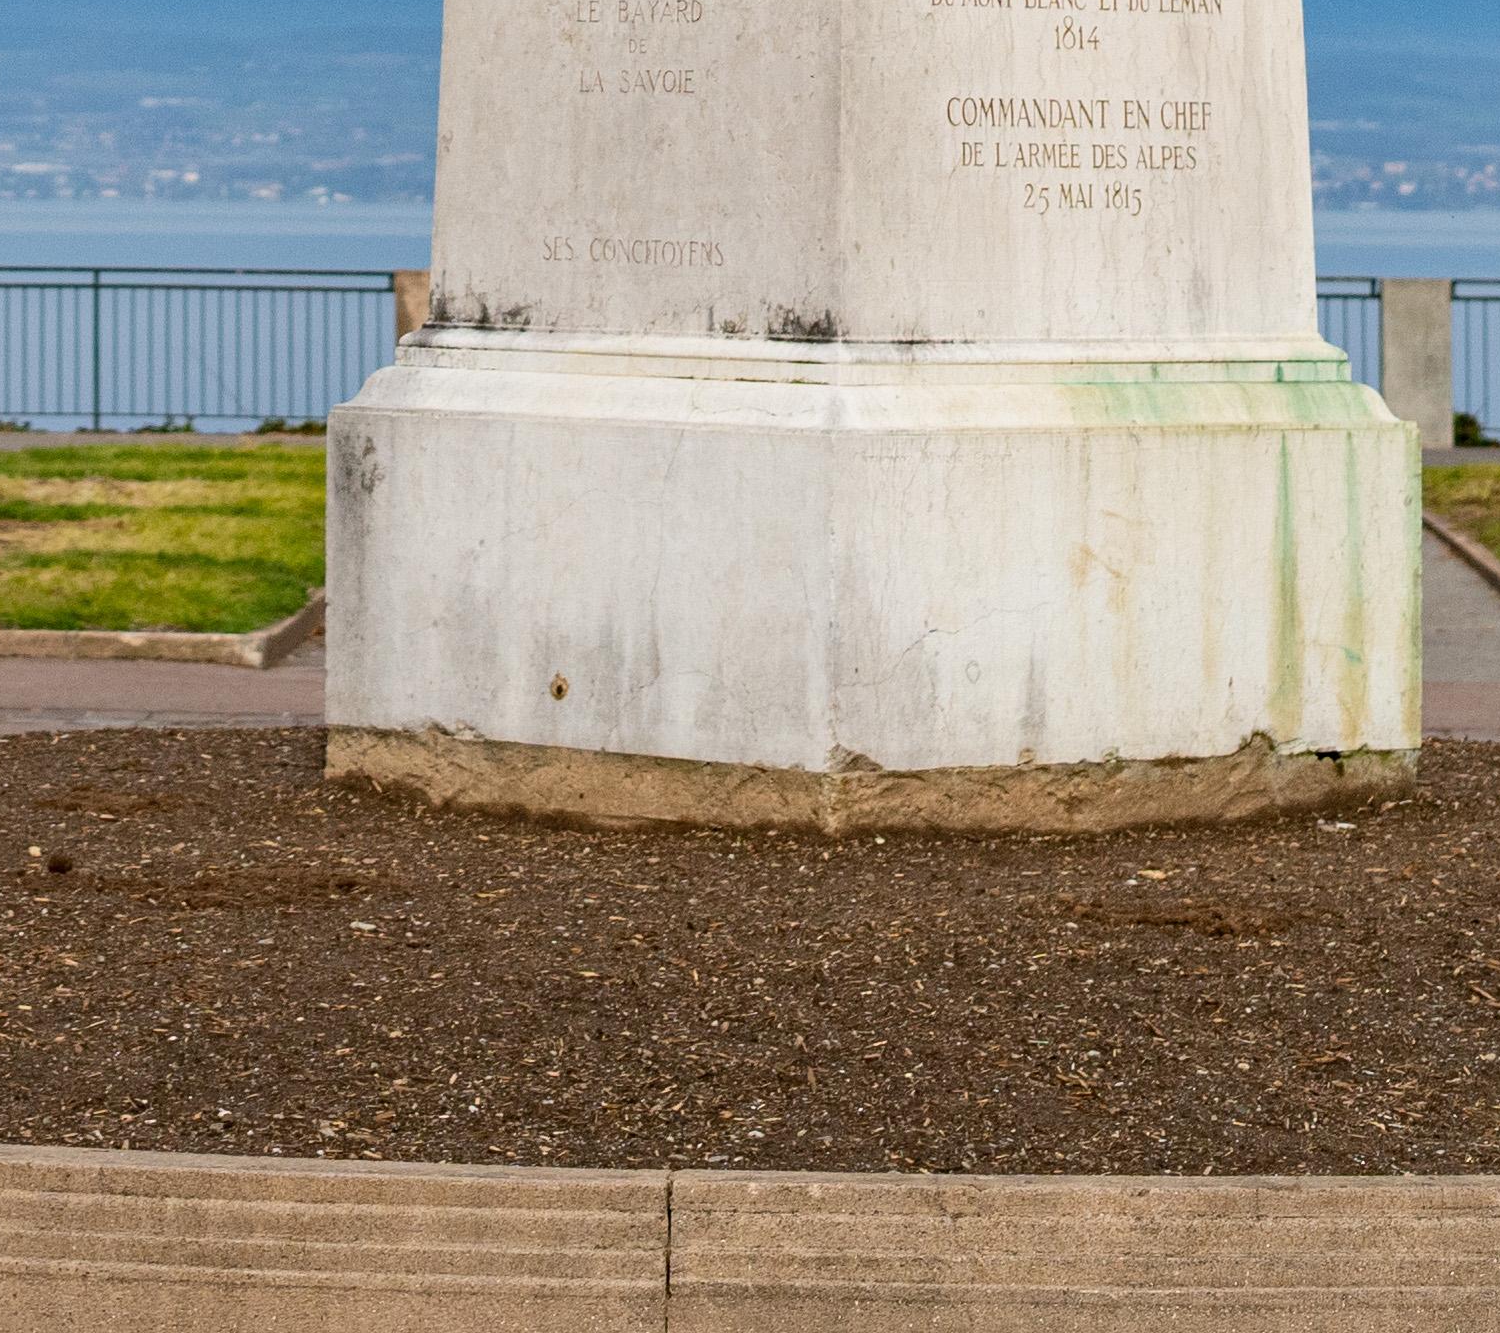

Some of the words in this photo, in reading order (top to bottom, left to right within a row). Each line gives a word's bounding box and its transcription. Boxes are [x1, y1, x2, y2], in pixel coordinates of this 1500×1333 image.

[576, 0, 600, 23] LE
[618, 0, 703, 24] BAYARD
[629, 38, 648, 54] DE
[1055, 15, 1100, 50] 1814
[579, 70, 604, 93] LA
[619, 69, 695, 94] SAVOIE
[947, 97, 1110, 130] COMMANDANT
[1123, 100, 1150, 130] EN
[1160, 101, 1212, 131] CHEF
[961, 141, 984, 167] DE
[995, 139, 1081, 169] L'ARMÉE
[1092, 144, 1128, 170] DES
[1136, 145, 1197, 171] ALPES
[1024, 183, 1050, 215] 25
[1058, 183, 1094, 210] MAI
[1105, 181, 1142, 216] 1815
[543, 236, 575, 261] SES
[589, 237, 724, 269] CONCITOYENS
